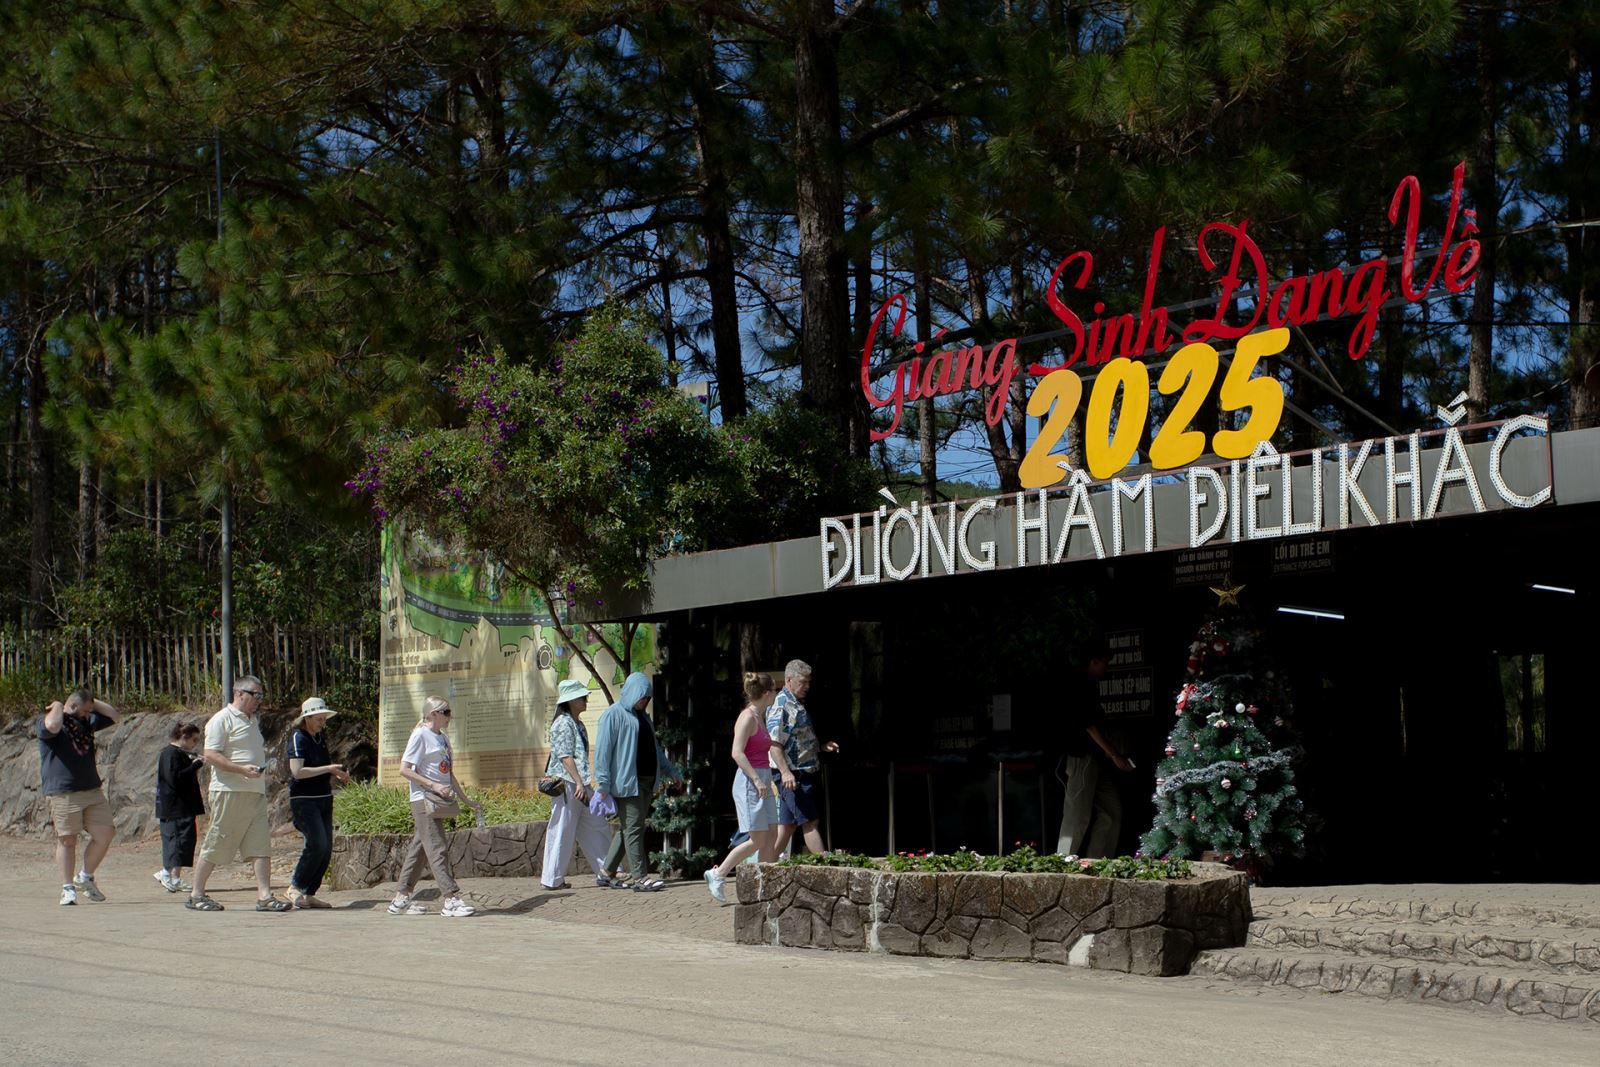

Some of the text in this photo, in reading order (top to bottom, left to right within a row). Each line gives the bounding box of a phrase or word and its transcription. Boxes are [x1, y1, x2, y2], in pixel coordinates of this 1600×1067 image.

[861, 294, 1020, 441] Giáng
[1029, 225, 1173, 376] Sinh
[1182, 219, 1391, 361] Đang
[1018, 327, 1290, 489] 2025
[820, 391, 1552, 590] ĐƯỜNG HẦM ĐIÊU KHẮC
[1215, 547, 1228, 558] CHO
[1274, 541, 1287, 560] LỐI
[1316, 540, 1331, 555] EM
[1124, 699, 1140, 712] LINE
[1141, 698, 1151, 711] UP
